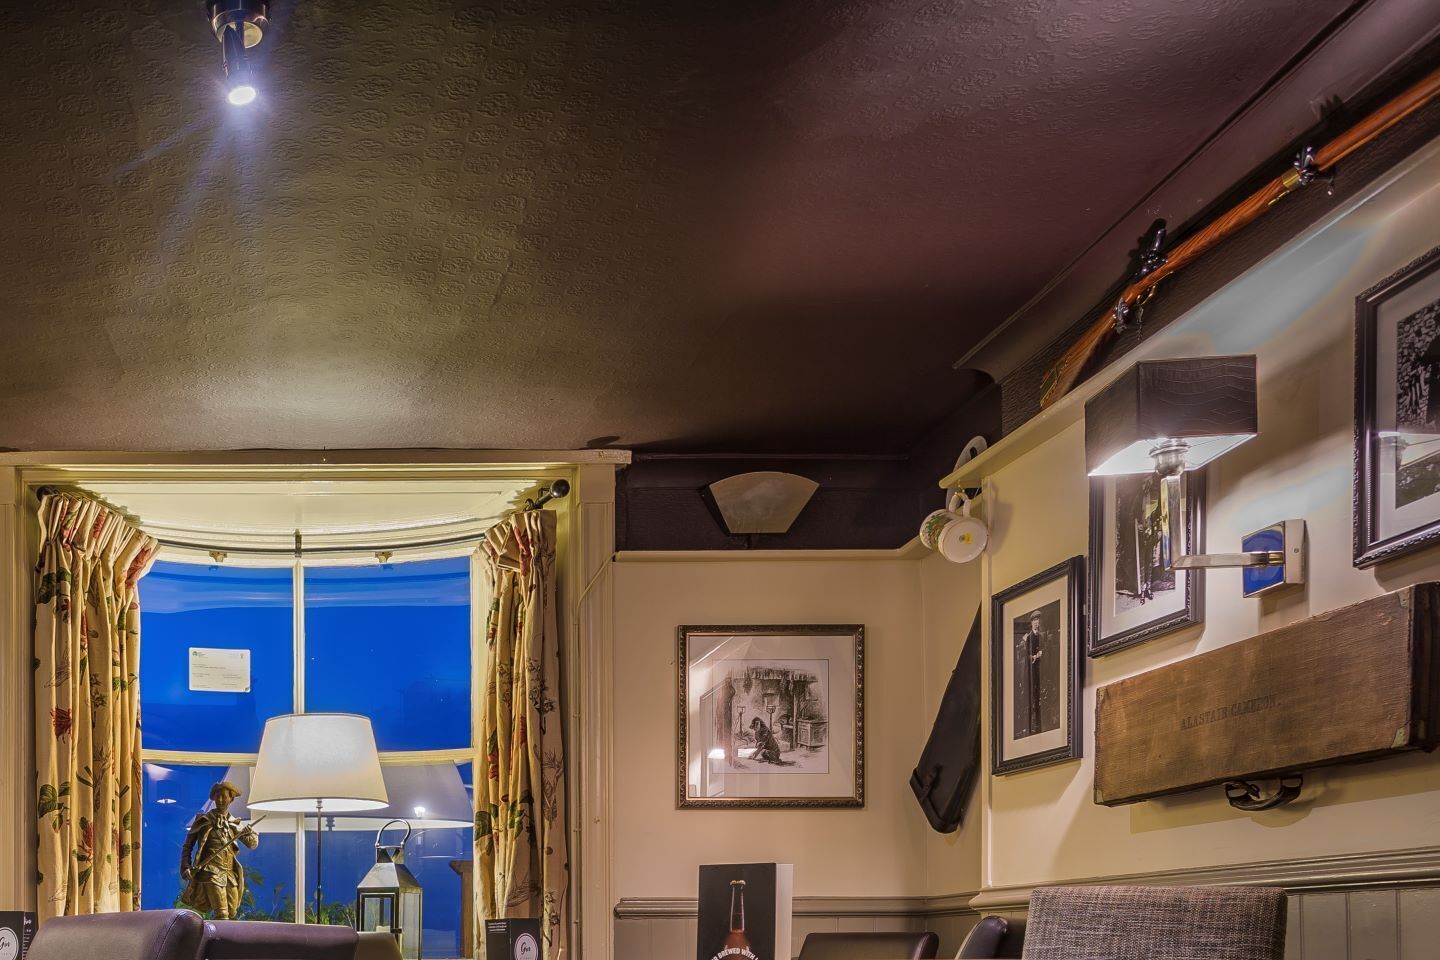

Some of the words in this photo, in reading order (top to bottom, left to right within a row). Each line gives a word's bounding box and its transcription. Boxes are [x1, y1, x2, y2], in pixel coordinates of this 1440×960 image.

[1180, 706, 1228, 731] ALASTAIR
[717, 947, 740, 959] BREWED
[741, 948, 756, 960] WITH
